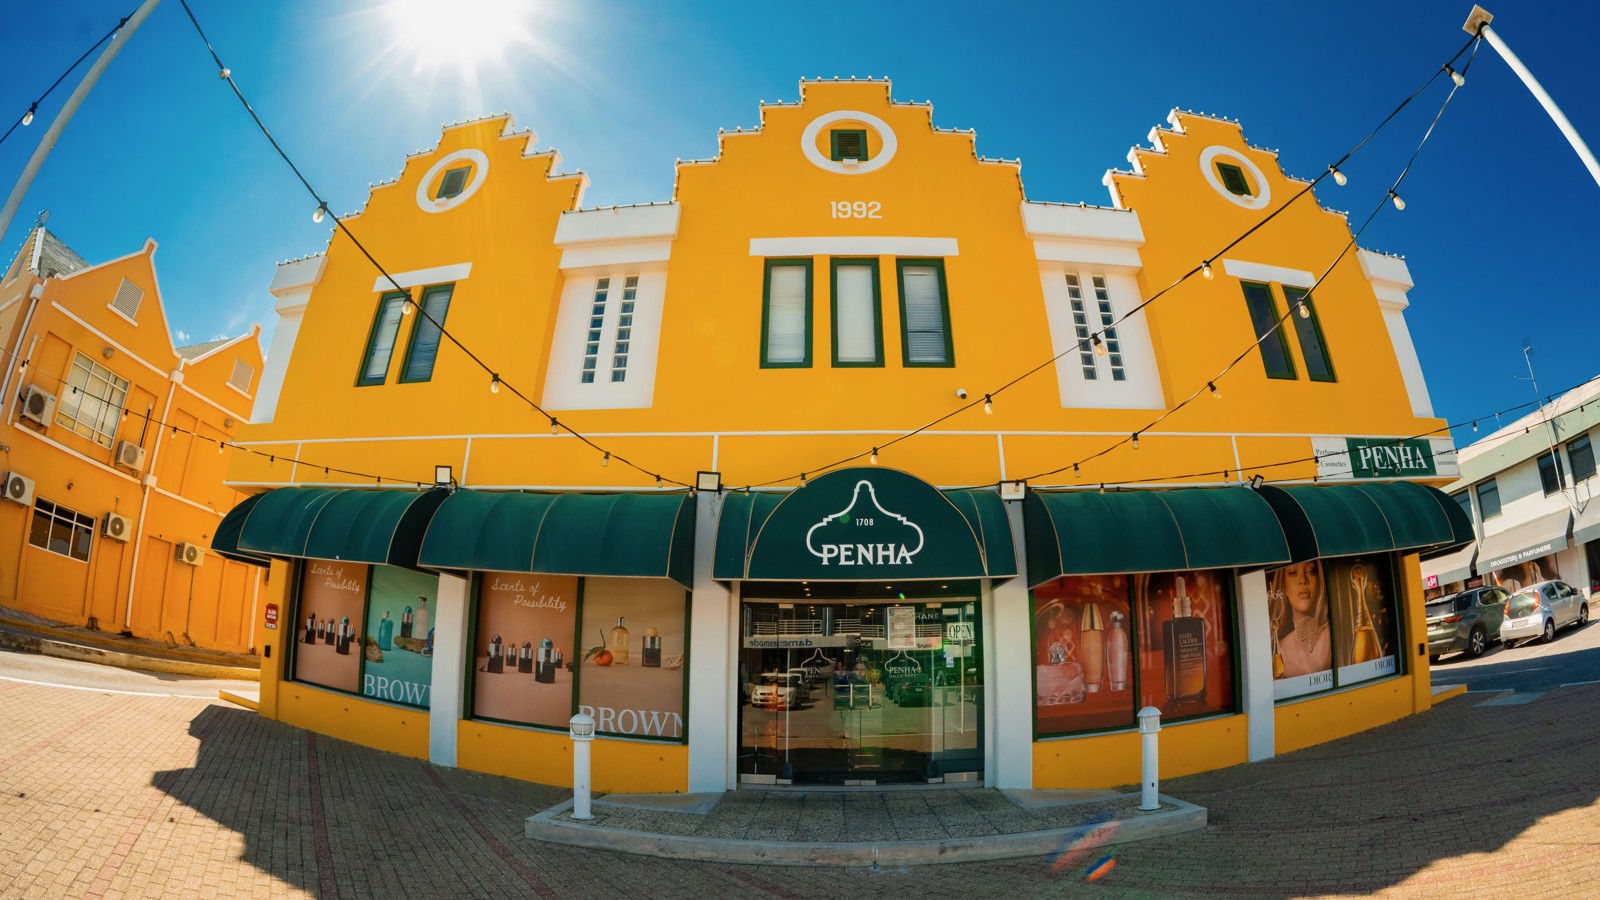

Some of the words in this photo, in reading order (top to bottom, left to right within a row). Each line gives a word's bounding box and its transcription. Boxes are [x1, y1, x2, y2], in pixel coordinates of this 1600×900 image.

[830, 200, 882, 219] 1992
[1320, 460, 1347, 468] Cosmetics
[1357, 445, 1428, 470] PENHA
[855, 518, 874, 526] 1708
[821, 543, 913, 565] PENHA
[1522, 543, 1552, 558] PARFUMERIE
[311, 562, 333, 576] Scents
[336, 567, 344, 580] of
[325, 577, 360, 594] Possibility
[491, 577, 526, 592] Scents
[529, 582, 540, 597] of
[513, 594, 567, 612] Possibility
[948, 624, 972, 639] OPEN
[889, 666, 917, 674] PENHA
[1374, 658, 1394, 671] DIOR
[1309, 672, 1332, 686] DIOR
